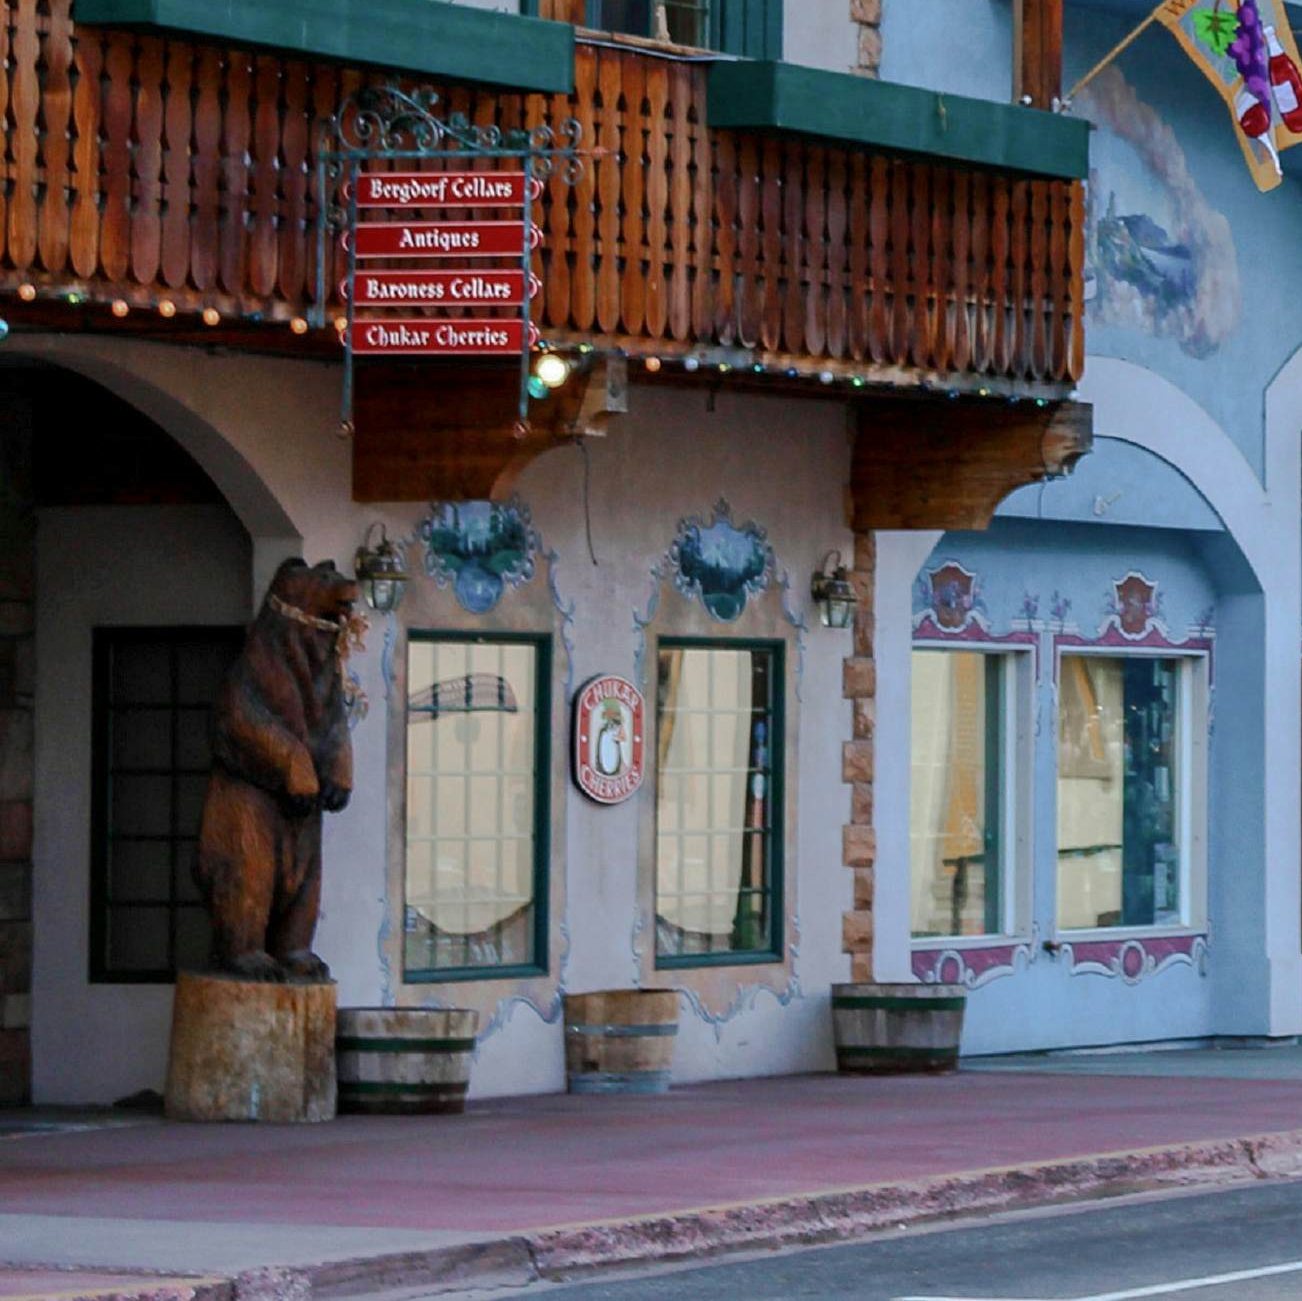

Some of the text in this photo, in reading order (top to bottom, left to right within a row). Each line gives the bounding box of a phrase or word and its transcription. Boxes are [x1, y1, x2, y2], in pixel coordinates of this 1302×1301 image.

[369, 176, 513, 203] Bergdorf Cellars
[399, 228, 480, 252] Antiques
[366, 277, 512, 298] Baroness Cellars
[365, 324, 509, 346] Chukar Cherries
[583, 680, 640, 712] CHUKAR
[581, 764, 640, 798] CHERRIES
